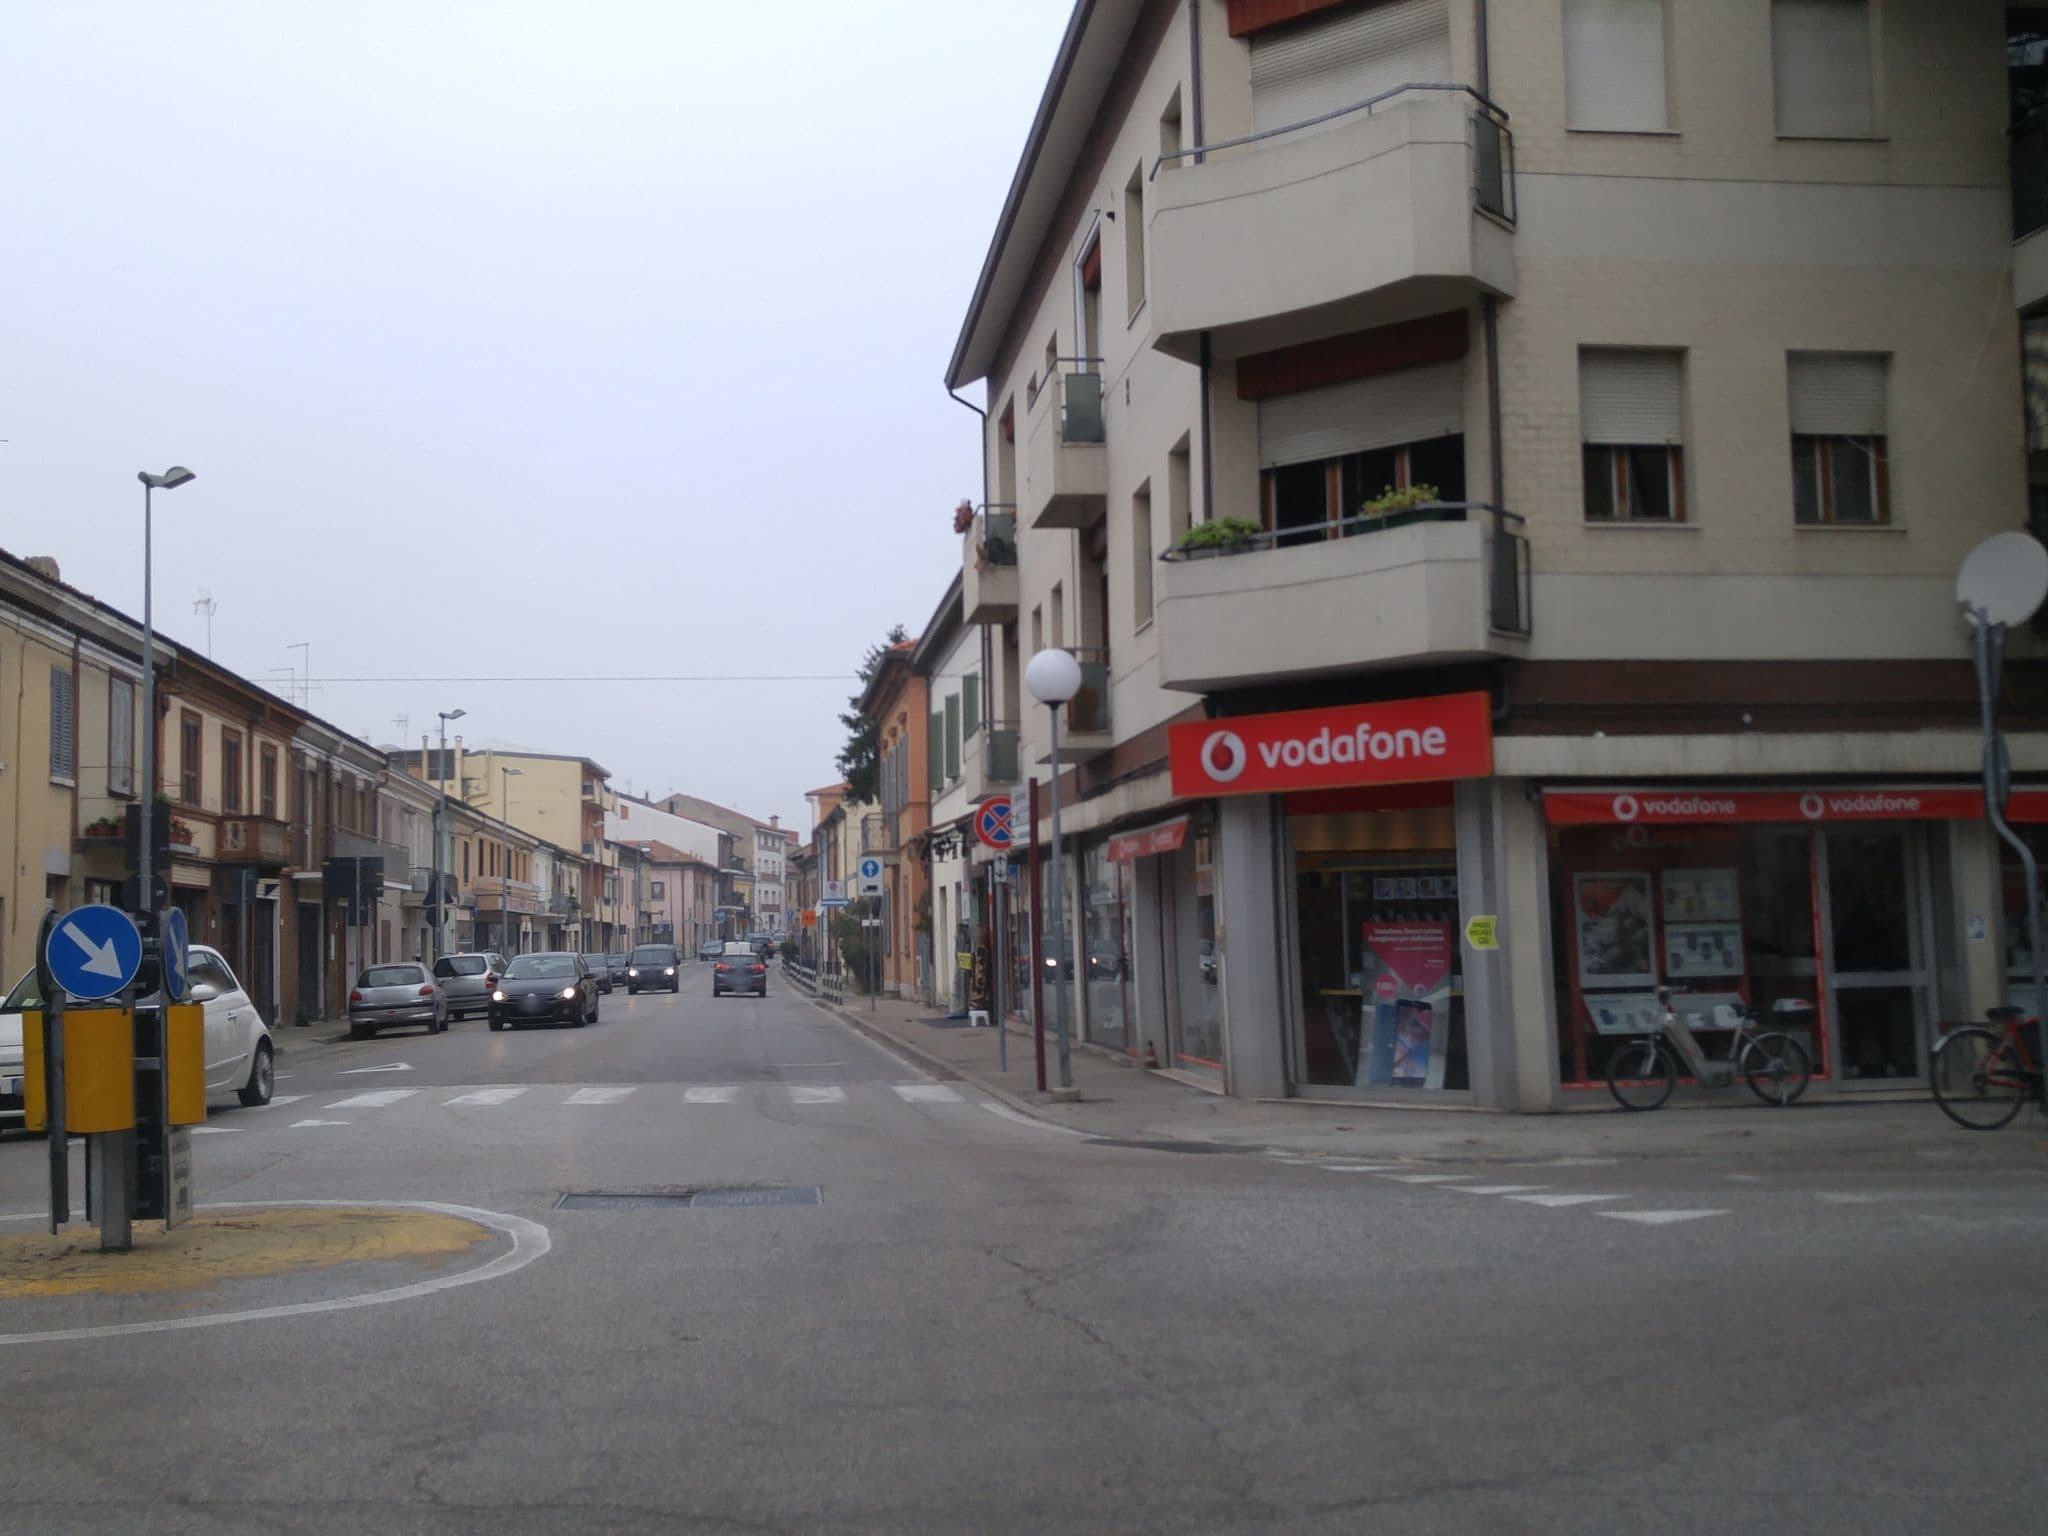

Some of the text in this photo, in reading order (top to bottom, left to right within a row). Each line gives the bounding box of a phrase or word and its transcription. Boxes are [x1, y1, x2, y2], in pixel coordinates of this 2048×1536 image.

[1258, 722, 1446, 769] vodafone
[1643, 796, 1736, 814] vodafone
[1828, 794, 1920, 812] vodafone
